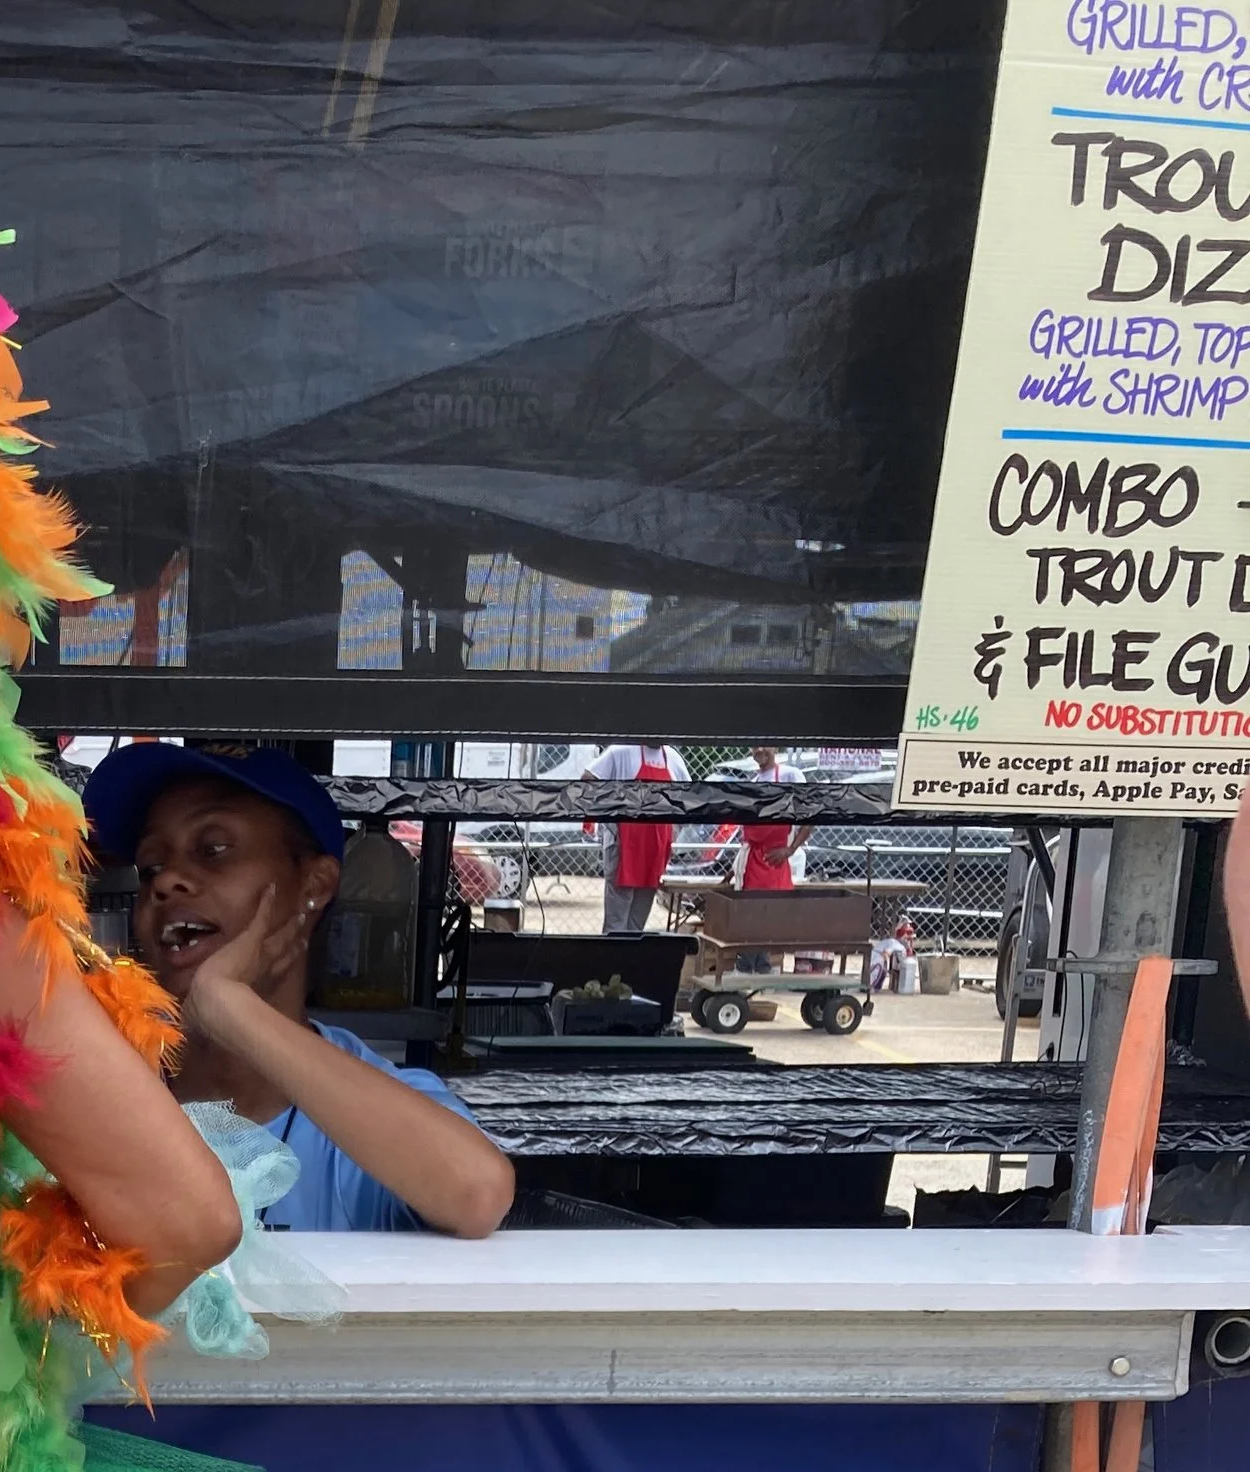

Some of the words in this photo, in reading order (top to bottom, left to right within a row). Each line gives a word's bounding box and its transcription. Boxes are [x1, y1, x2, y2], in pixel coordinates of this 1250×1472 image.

[1067, 0, 1247, 60] GRILLED,
[1105, 56, 1184, 104] with
[1029, 309, 1181, 366] GRILLED,
[1018, 361, 1097, 407] with
[1102, 368, 1249, 420] SHRIMP
[988, 453, 1200, 538] COMBO
[1026, 546, 1225, 608] TROUT
[973, 615, 1013, 700] &
[1023, 627, 1161, 692] FILE
[1045, 700, 1082, 728] NO
[912, 776, 1010, 797] pre-paid
[1017, 780, 1086, 799] cards,
[1093, 780, 1162, 802] Apple
[1169, 782, 1216, 804] Pay,
[958, 751, 991, 770] We
[997, 753, 1073, 773] accept
[1079, 754, 1109, 773] all
[1116, 756, 1186, 778] major
